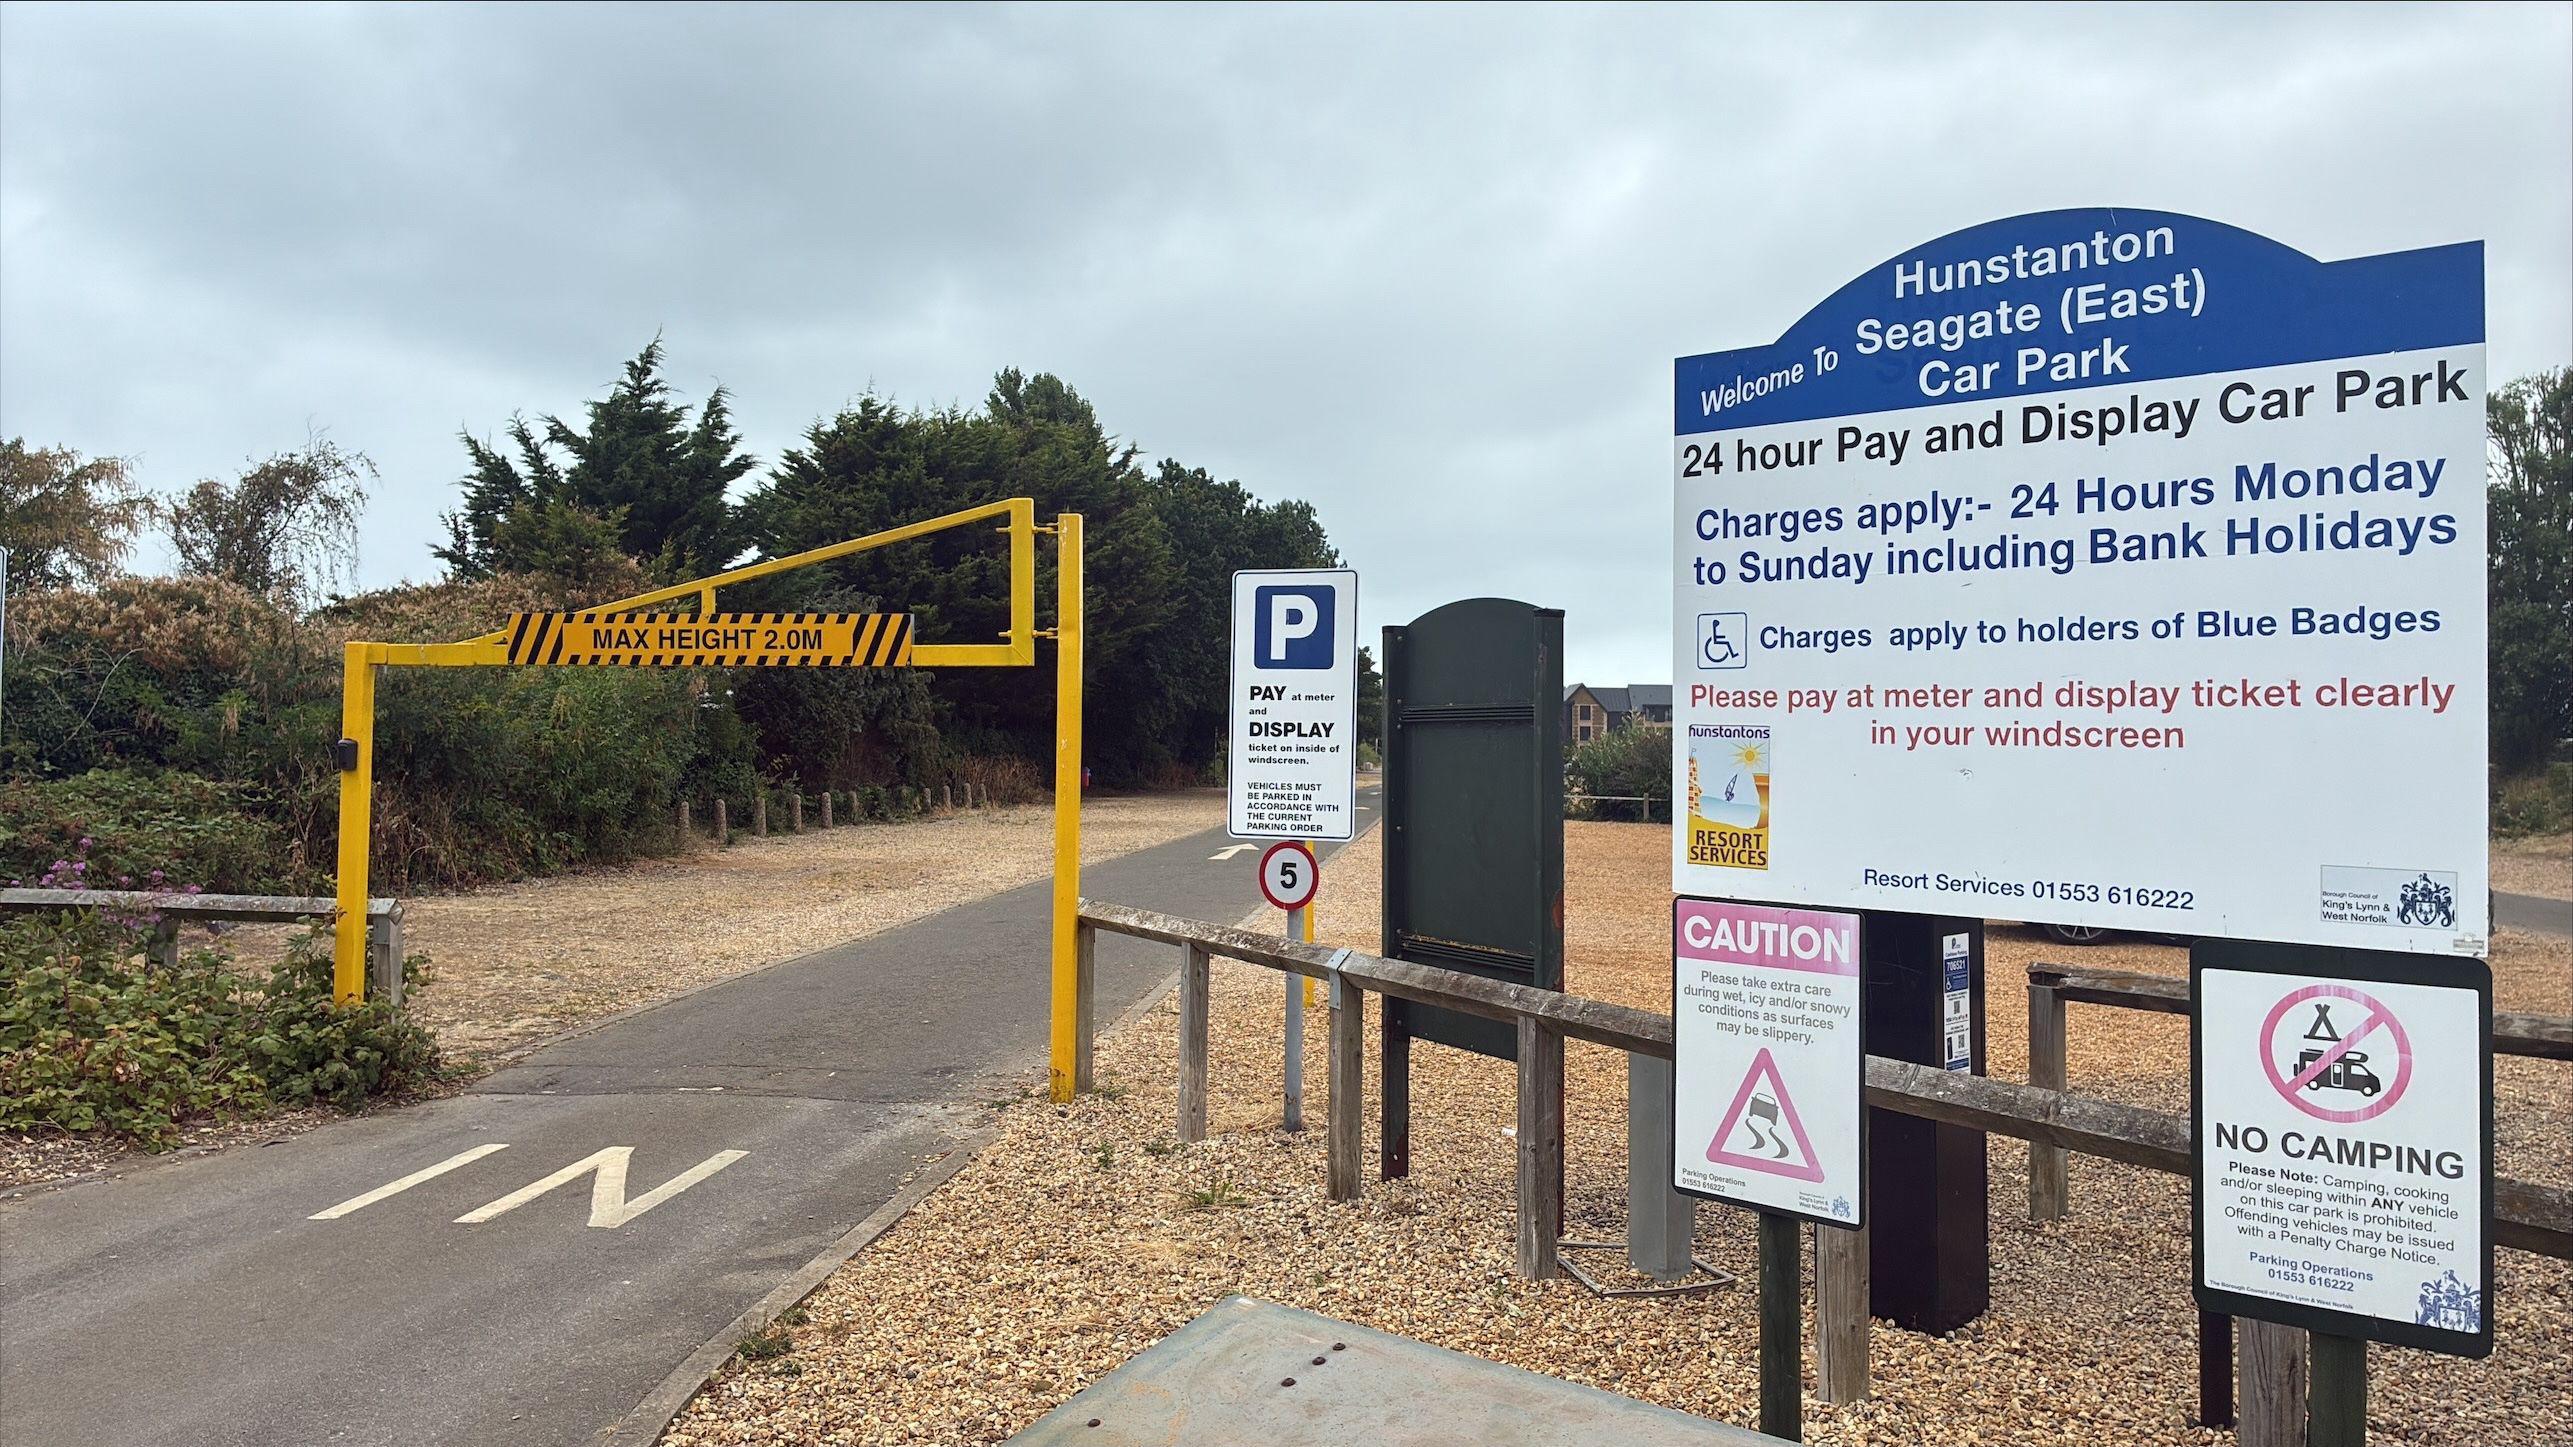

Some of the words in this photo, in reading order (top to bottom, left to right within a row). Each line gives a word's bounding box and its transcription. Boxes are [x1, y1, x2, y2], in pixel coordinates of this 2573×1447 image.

[1895, 225, 2174, 299] Hunstanton
[1856, 298, 2042, 355] Seagate
[2060, 269, 2207, 334] (East)
[1701, 362, 1804, 416] Welcome
[1814, 346, 1838, 376] To
[1919, 359, 2000, 397] Car
[2016, 339, 2130, 384] Park
[1682, 445, 1724, 478] 24
[1737, 435, 1823, 474] hour
[1837, 429, 1909, 469] Pay
[1925, 412, 2003, 452] and
[2022, 397, 2201, 449] Display
[2219, 382, 2315, 424] Car
[2336, 359, 2469, 414] Park
[1696, 500, 1844, 548] Charges
[1857, 492, 1992, 536] apply:-
[2010, 485, 2059, 519] 24
[2076, 472, 2215, 516] Hours
[2234, 454, 2446, 506] Monday
[1693, 556, 1727, 586] to
[1738, 546, 1875, 587] Sunday
[1886, 535, 2075, 578] including
[2090, 523, 2207, 563] Bank
[2226, 510, 2458, 564] Holidays
[593, 629, 649, 650] MAX
[659, 629, 756, 650] HEIGHT
[765, 629, 821, 650] 2.0M
[1270, 595, 1318, 660] P
[1759, 623, 1873, 654] Charges
[1888, 621, 1968, 651] apply
[1978, 621, 2006, 644] to
[2017, 615, 2140, 643] holders
[2151, 612, 2184, 639] of
[2198, 610, 2278, 638] Blue
[2290, 605, 2441, 642] Badges
[1249, 685, 1287, 701] PAY
[1292, 693, 1301, 701] at
[1691, 684, 1779, 709] Please
[1787, 687, 1837, 713] pay
[1846, 685, 1875, 709] at
[1884, 684, 1974, 709] meter
[1983, 681, 2043, 708] and
[2054, 680, 2180, 714] display
[2192, 678, 2300, 709] ticket
[2315, 676, 2455, 714] clearly
[1249, 707, 1267, 716] and
[1249, 722, 1335, 737] DISPLAY
[1689, 726, 1770, 738] hunstantons
[1870, 722, 1896, 745] in
[1904, 724, 1976, 752] your
[1986, 720, 2186, 750] windscreen
[1248, 744, 1278, 753] ticket
[1296, 744, 1326, 752] inside
[1329, 744, 1340, 752] of
[1248, 755, 1309, 765] windscreen.
[1248, 782, 1292, 791] VEHICLES
[1295, 783, 1321, 791] MUST
[1248, 792, 1260, 800] BE
[1263, 792, 1299, 801] PARKED
[1302, 793, 1312, 801] IN
[1247, 802, 1312, 812] ACCORDANCE
[1315, 804, 1339, 812] WITH
[1248, 812, 1266, 821] THE
[1268, 813, 1312, 822] CURRENT
[1247, 822, 1287, 831] PARKING
[1290, 823, 1323, 832] ORDER
[1696, 830, 1762, 849] RESORT
[1690, 846, 1766, 866] SERVICES
[1281, 862, 1297, 889] 5
[1863, 869, 1930, 890] Resort
[1935, 874, 2025, 898] Services
[2032, 879, 2101, 903] 01553
[2108, 886, 2195, 909] 616222
[2322, 900, 2352, 909] King's
[2356, 903, 2379, 911] Lynn
[2323, 911, 2347, 920] West
[2351, 913, 2387, 923] Norfolk
[1684, 915, 1850, 963] CAUTION
[1701, 971, 1739, 986] Please
[1742, 974, 1767, 989] take
[1771, 979, 1801, 993] extra
[1805, 984, 1831, 997] care
[1684, 985, 1720, 1002] during
[1723, 990, 1746, 1003] wet,
[1749, 993, 1766, 1006] icy
[1769, 995, 1807, 1009] and/or
[1810, 1000, 1850, 1018] snowy
[1698, 1003, 1759, 1020] conditions
[1763, 1010, 1777, 1022] as
[1781, 1014, 1834, 1030] surfaces
[1717, 1021, 1741, 1037] may
[1744, 1023, 1759, 1036] be
[1762, 1027, 1814, 1044] slippery.
[2216, 1122, 2268, 1153] NO
[2281, 1132, 2464, 1179] CAMPING
[308, 1142, 751, 1228] IN
[1682, 1168, 1707, 1180] Parking
[1709, 1173, 1746, 1187] Operations
[1682, 1178, 1700, 1187] 01553
[1702, 1182, 1725, 1192] 616222
[2229, 1161, 2276, 1178] Please
[2280, 1168, 2318, 1184] Note:
[2323, 1175, 2390, 1196] Camping,
[2394, 1185, 2449, 1204] cooking
[2221, 1177, 2263, 1192] and/or
[2267, 1180, 2322, 1203] sleeping
[2327, 1190, 2367, 1207] within
[2371, 1197, 2404, 1212] ANY
[2408, 1203, 2459, 1220] vehicle
[2240, 1195, 2257, 1205] on
[2261, 1195, 2284, 1210] this
[2288, 1201, 2310, 1214] car
[2313, 1203, 2344, 1221] park
[2348, 1208, 2359, 1222] is
[2363, 1212, 2437, 1234] prohibited.
[2225, 1206, 2289, 1230] Offending
[2292, 1216, 2349, 1237] vehicles
[2353, 1226, 2382, 1244] may
[2386, 1231, 2404, 1245] be
[2408, 1235, 2455, 1252] issued
[2238, 1224, 2264, 1240] with
[2268, 1229, 2277, 1241] a
[2281, 1230, 2331, 1252] Penalty
[2335, 1238, 2387, 1259] Charge
[2391, 1247, 2440, 1266] Notice.
[2250, 1252, 2298, 1271] Parking
[2302, 1261, 2373, 1281] Operations
[2268, 1268, 2305, 1283] 01553
[2309, 1275, 2354, 1292] 616222
